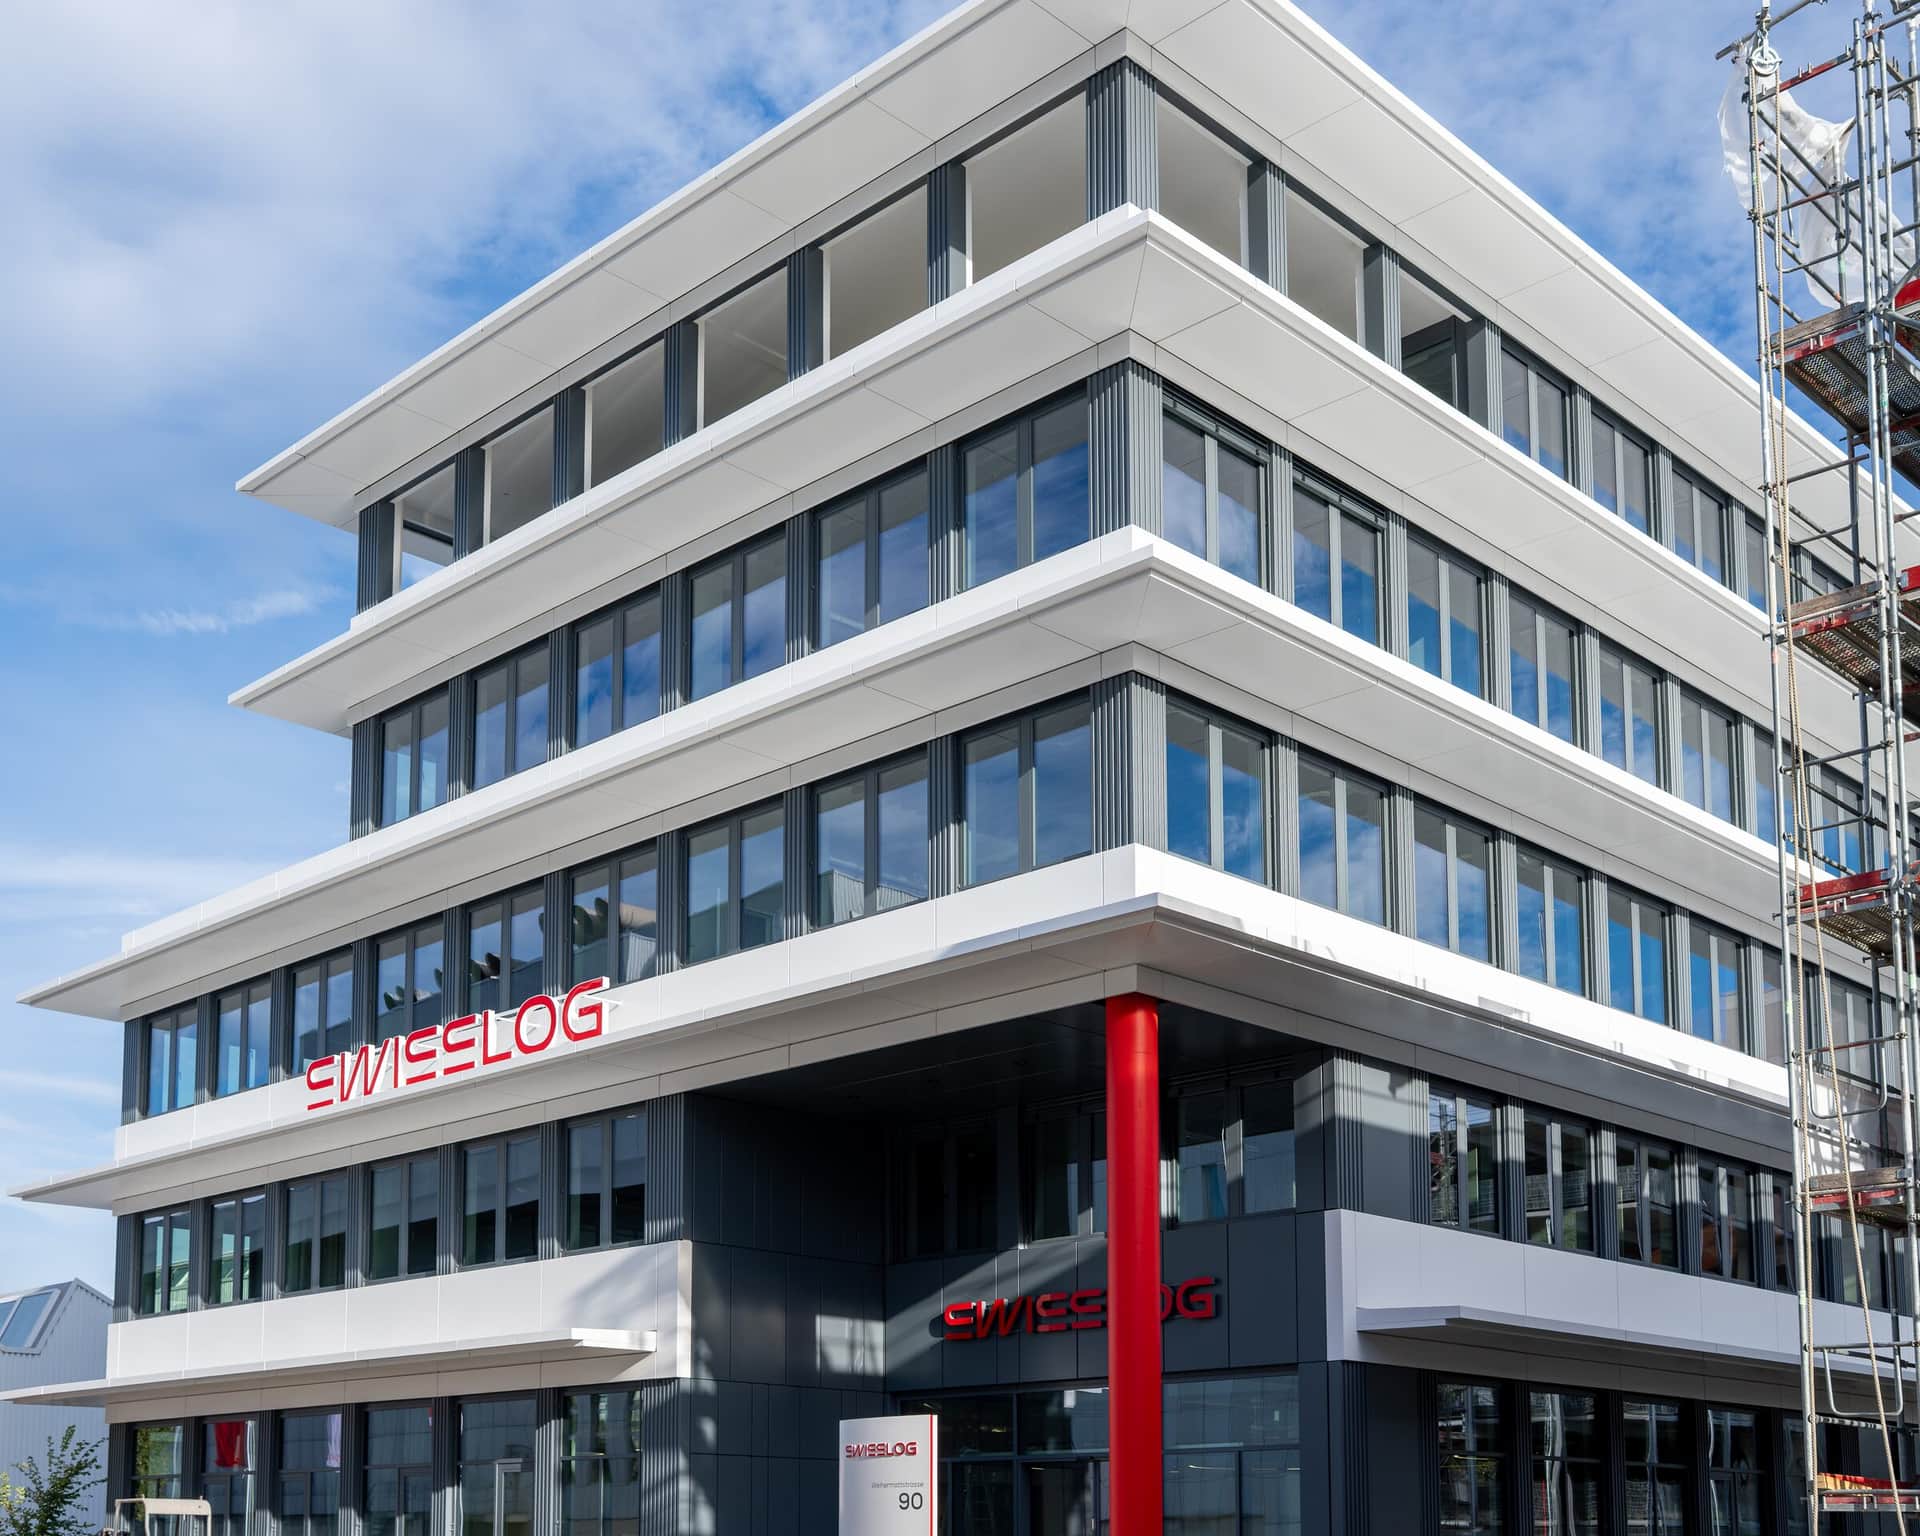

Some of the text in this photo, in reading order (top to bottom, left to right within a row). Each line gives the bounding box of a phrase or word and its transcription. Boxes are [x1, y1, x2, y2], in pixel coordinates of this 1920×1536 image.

[306, 976, 606, 1111] SWISSLOG
[944, 1276, 1215, 1341] SWISSG
[845, 1441, 917, 1459] SWISSLOG
[898, 1492, 924, 1511] 90
